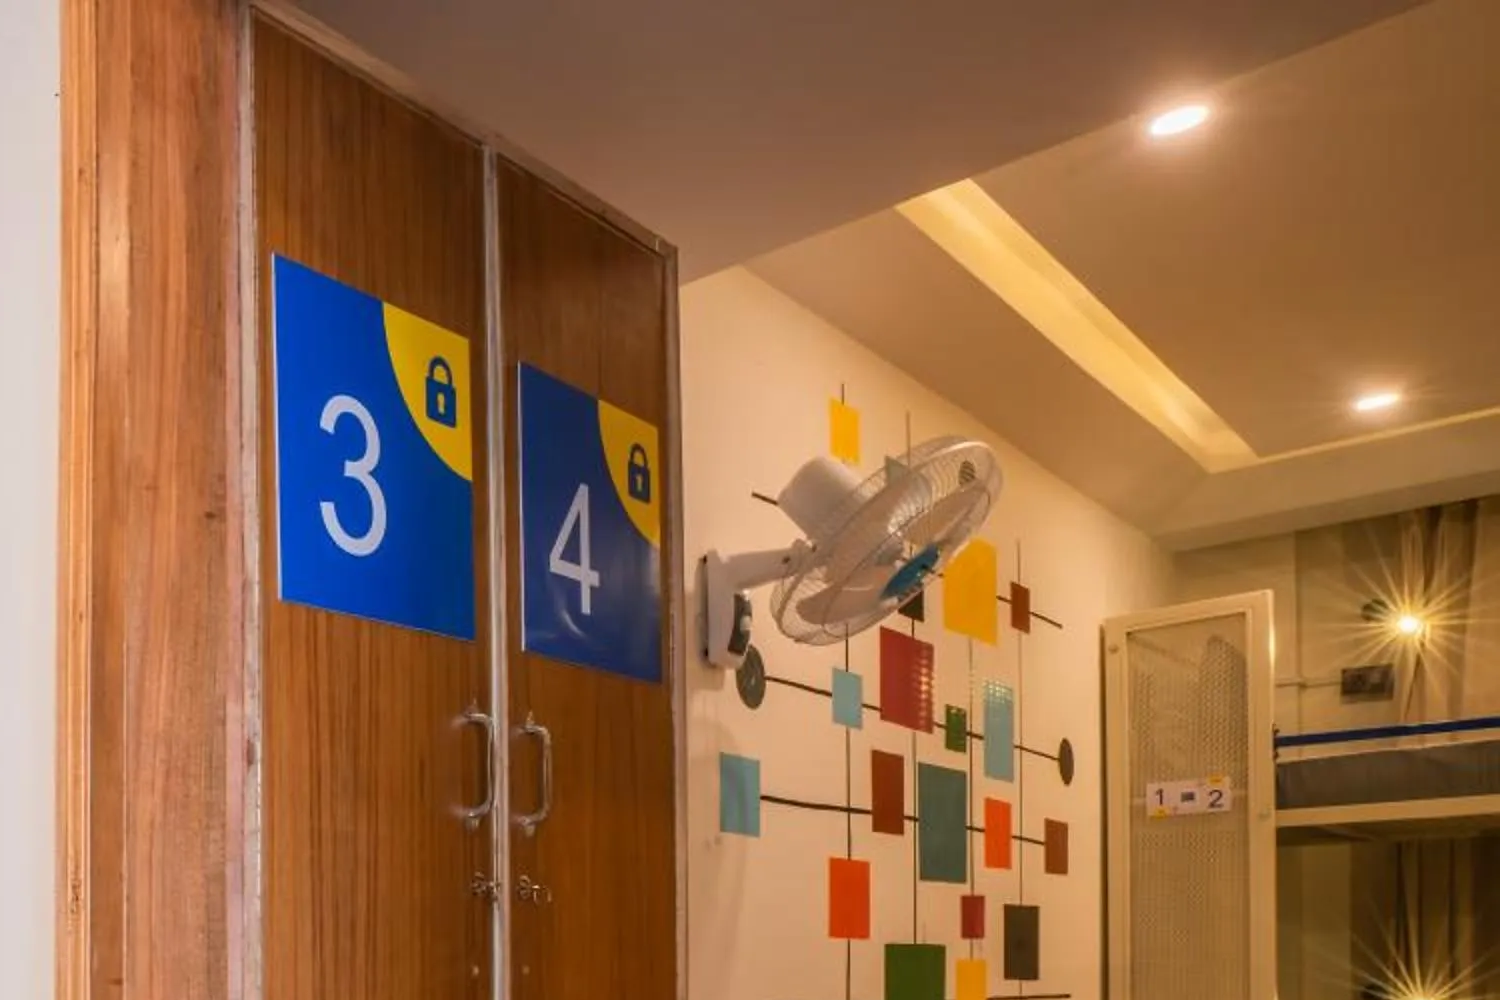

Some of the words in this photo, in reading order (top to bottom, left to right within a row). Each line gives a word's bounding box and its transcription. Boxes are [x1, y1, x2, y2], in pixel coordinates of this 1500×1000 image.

[319, 394, 387, 557] 3
[549, 483, 600, 616] 4
[1156, 788, 1164, 805] 1
[1208, 789, 1225, 808] 2
